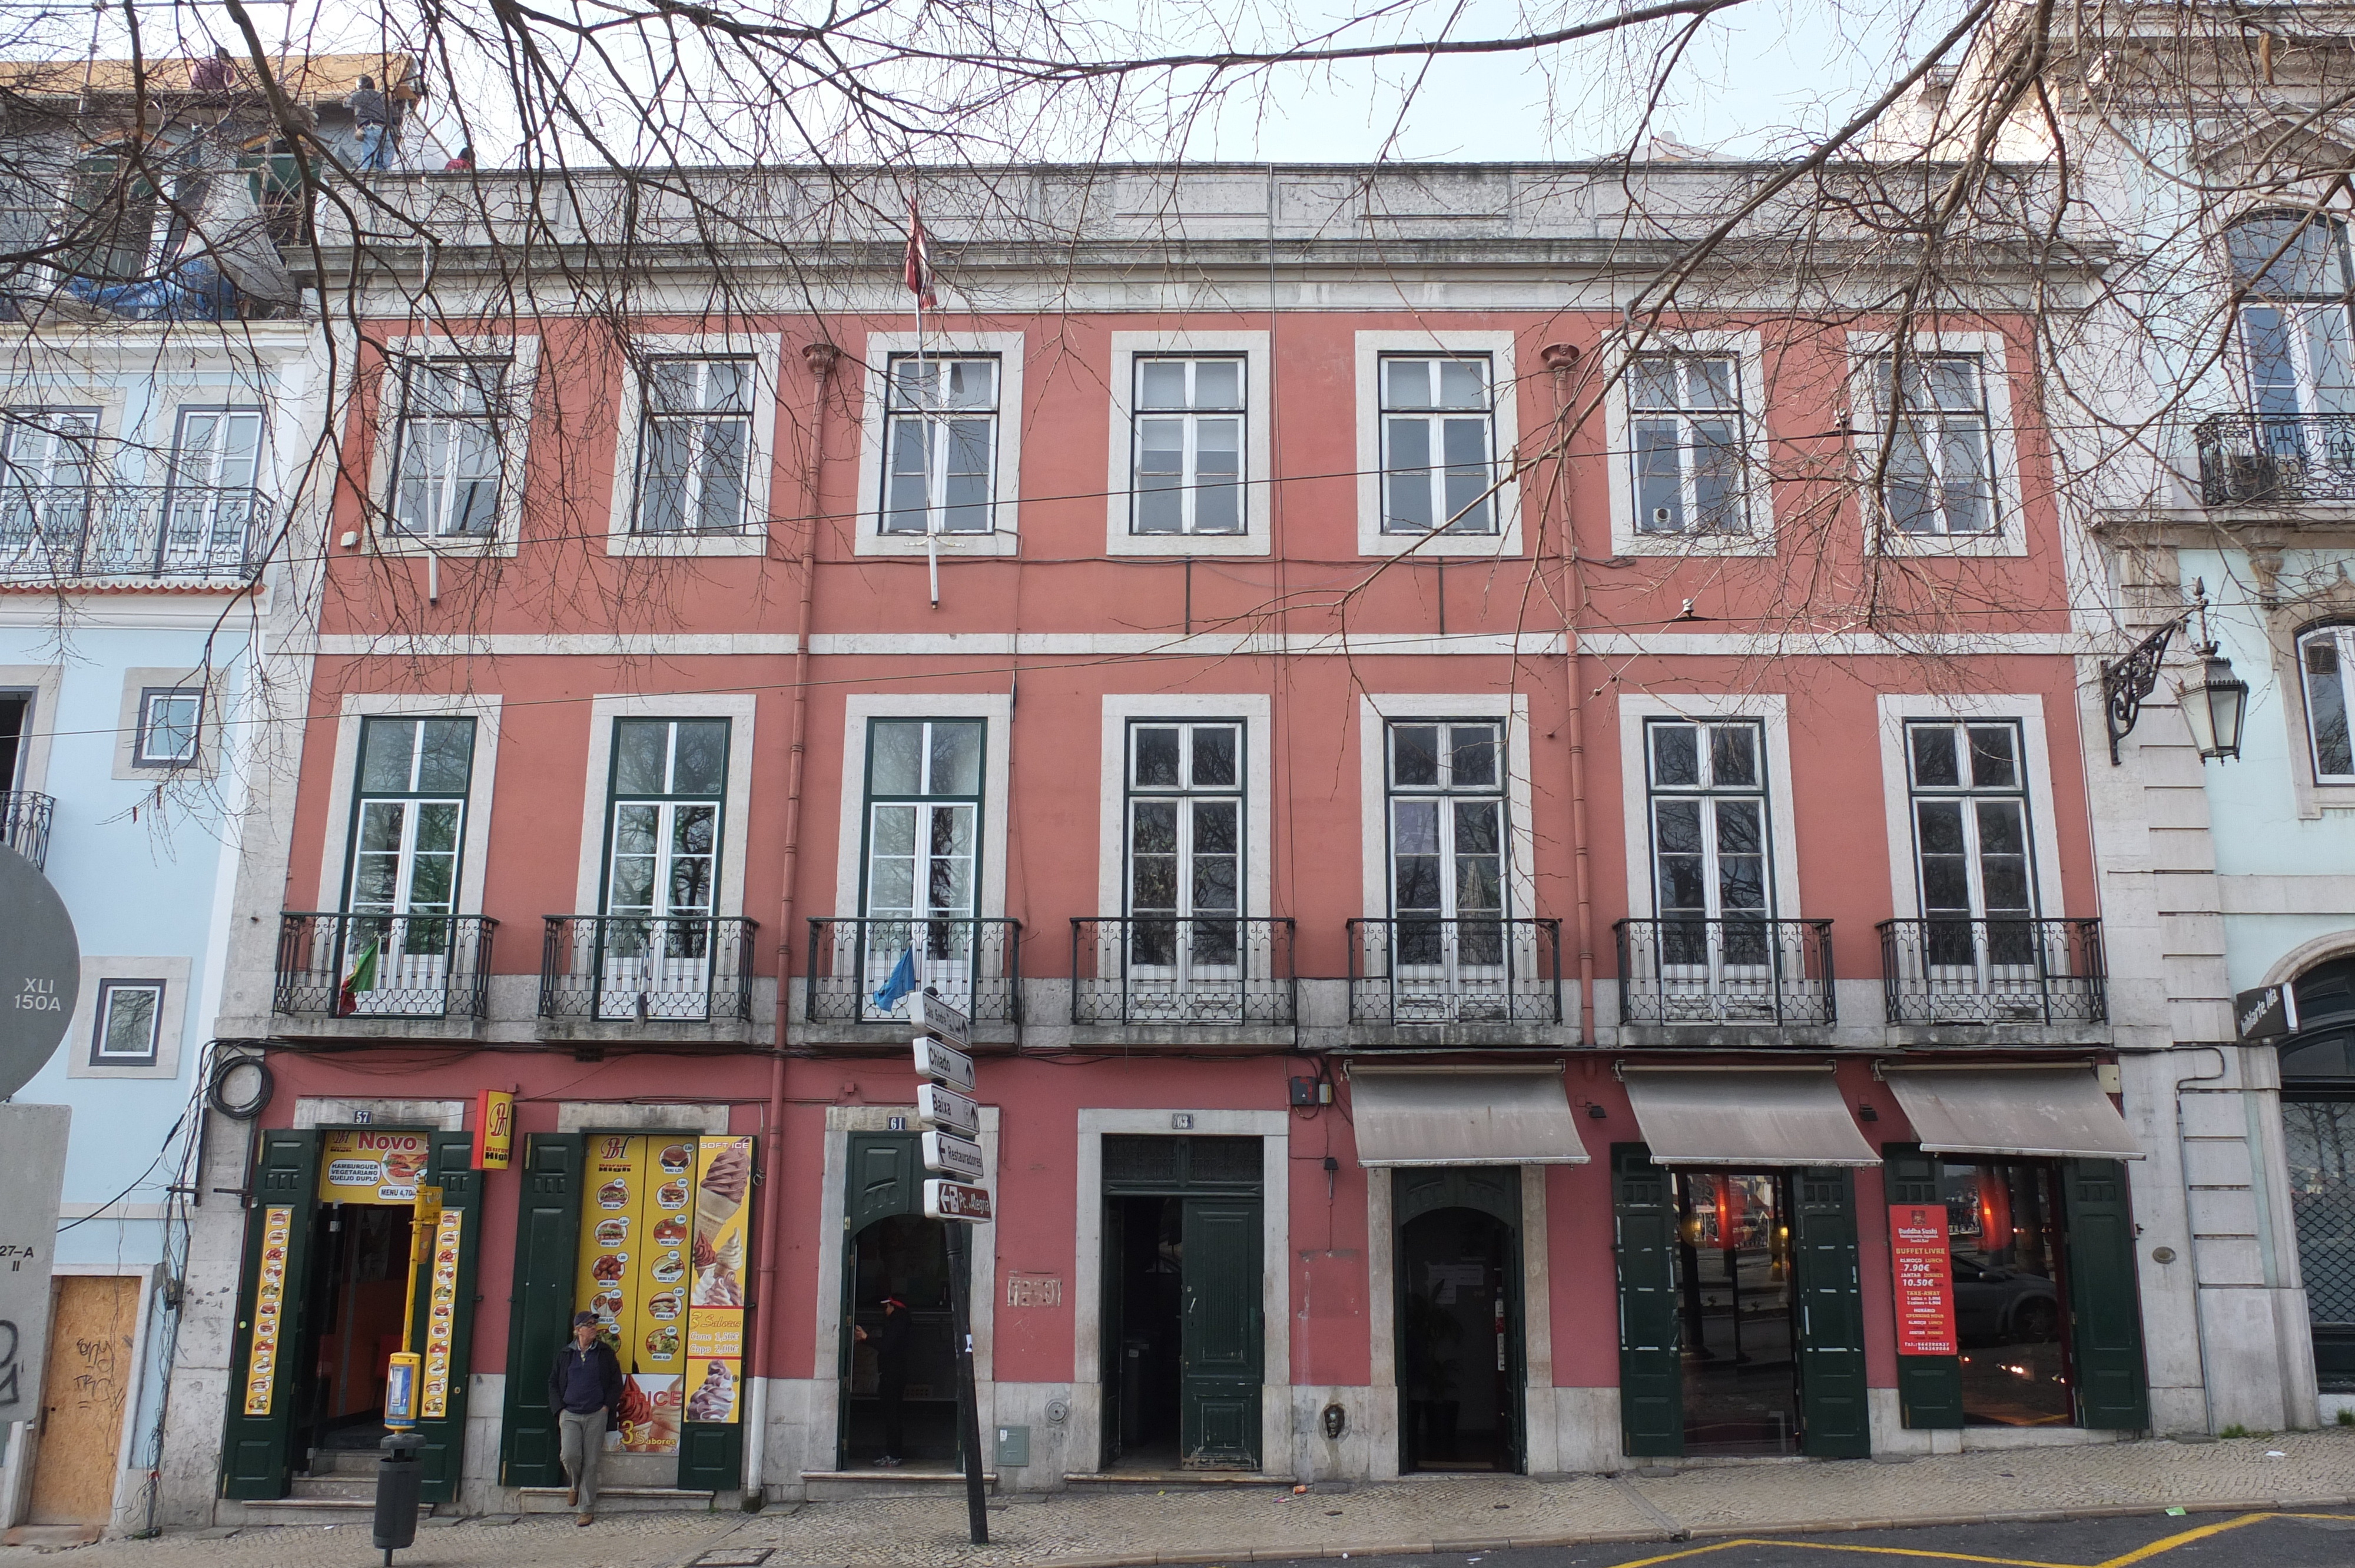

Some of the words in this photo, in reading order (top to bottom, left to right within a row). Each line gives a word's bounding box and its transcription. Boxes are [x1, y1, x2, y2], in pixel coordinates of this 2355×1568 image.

[24, 978, 54, 994] XLI
[15, 994, 61, 1011] 150A
[924, 1002, 934, 1019] Cais
[928, 1047, 951, 1072] Chiado
[932, 1093, 951, 1116] Baixa
[356, 1111, 369, 1124] 57
[890, 1118, 903, 1130] 61
[1177, 1115, 1189, 1128] 63
[948, 1145, 982, 1168] Restauradores
[1903, 1264, 1930, 1272] 7.90€
[1903, 1278, 1934, 1287] 10.50€
[689, 1311, 702, 1330] 3
[714, 1344, 739, 1354] 2,00€
[621, 1420, 634, 1444] 3
[635, 1430, 676, 1445] Sabores
